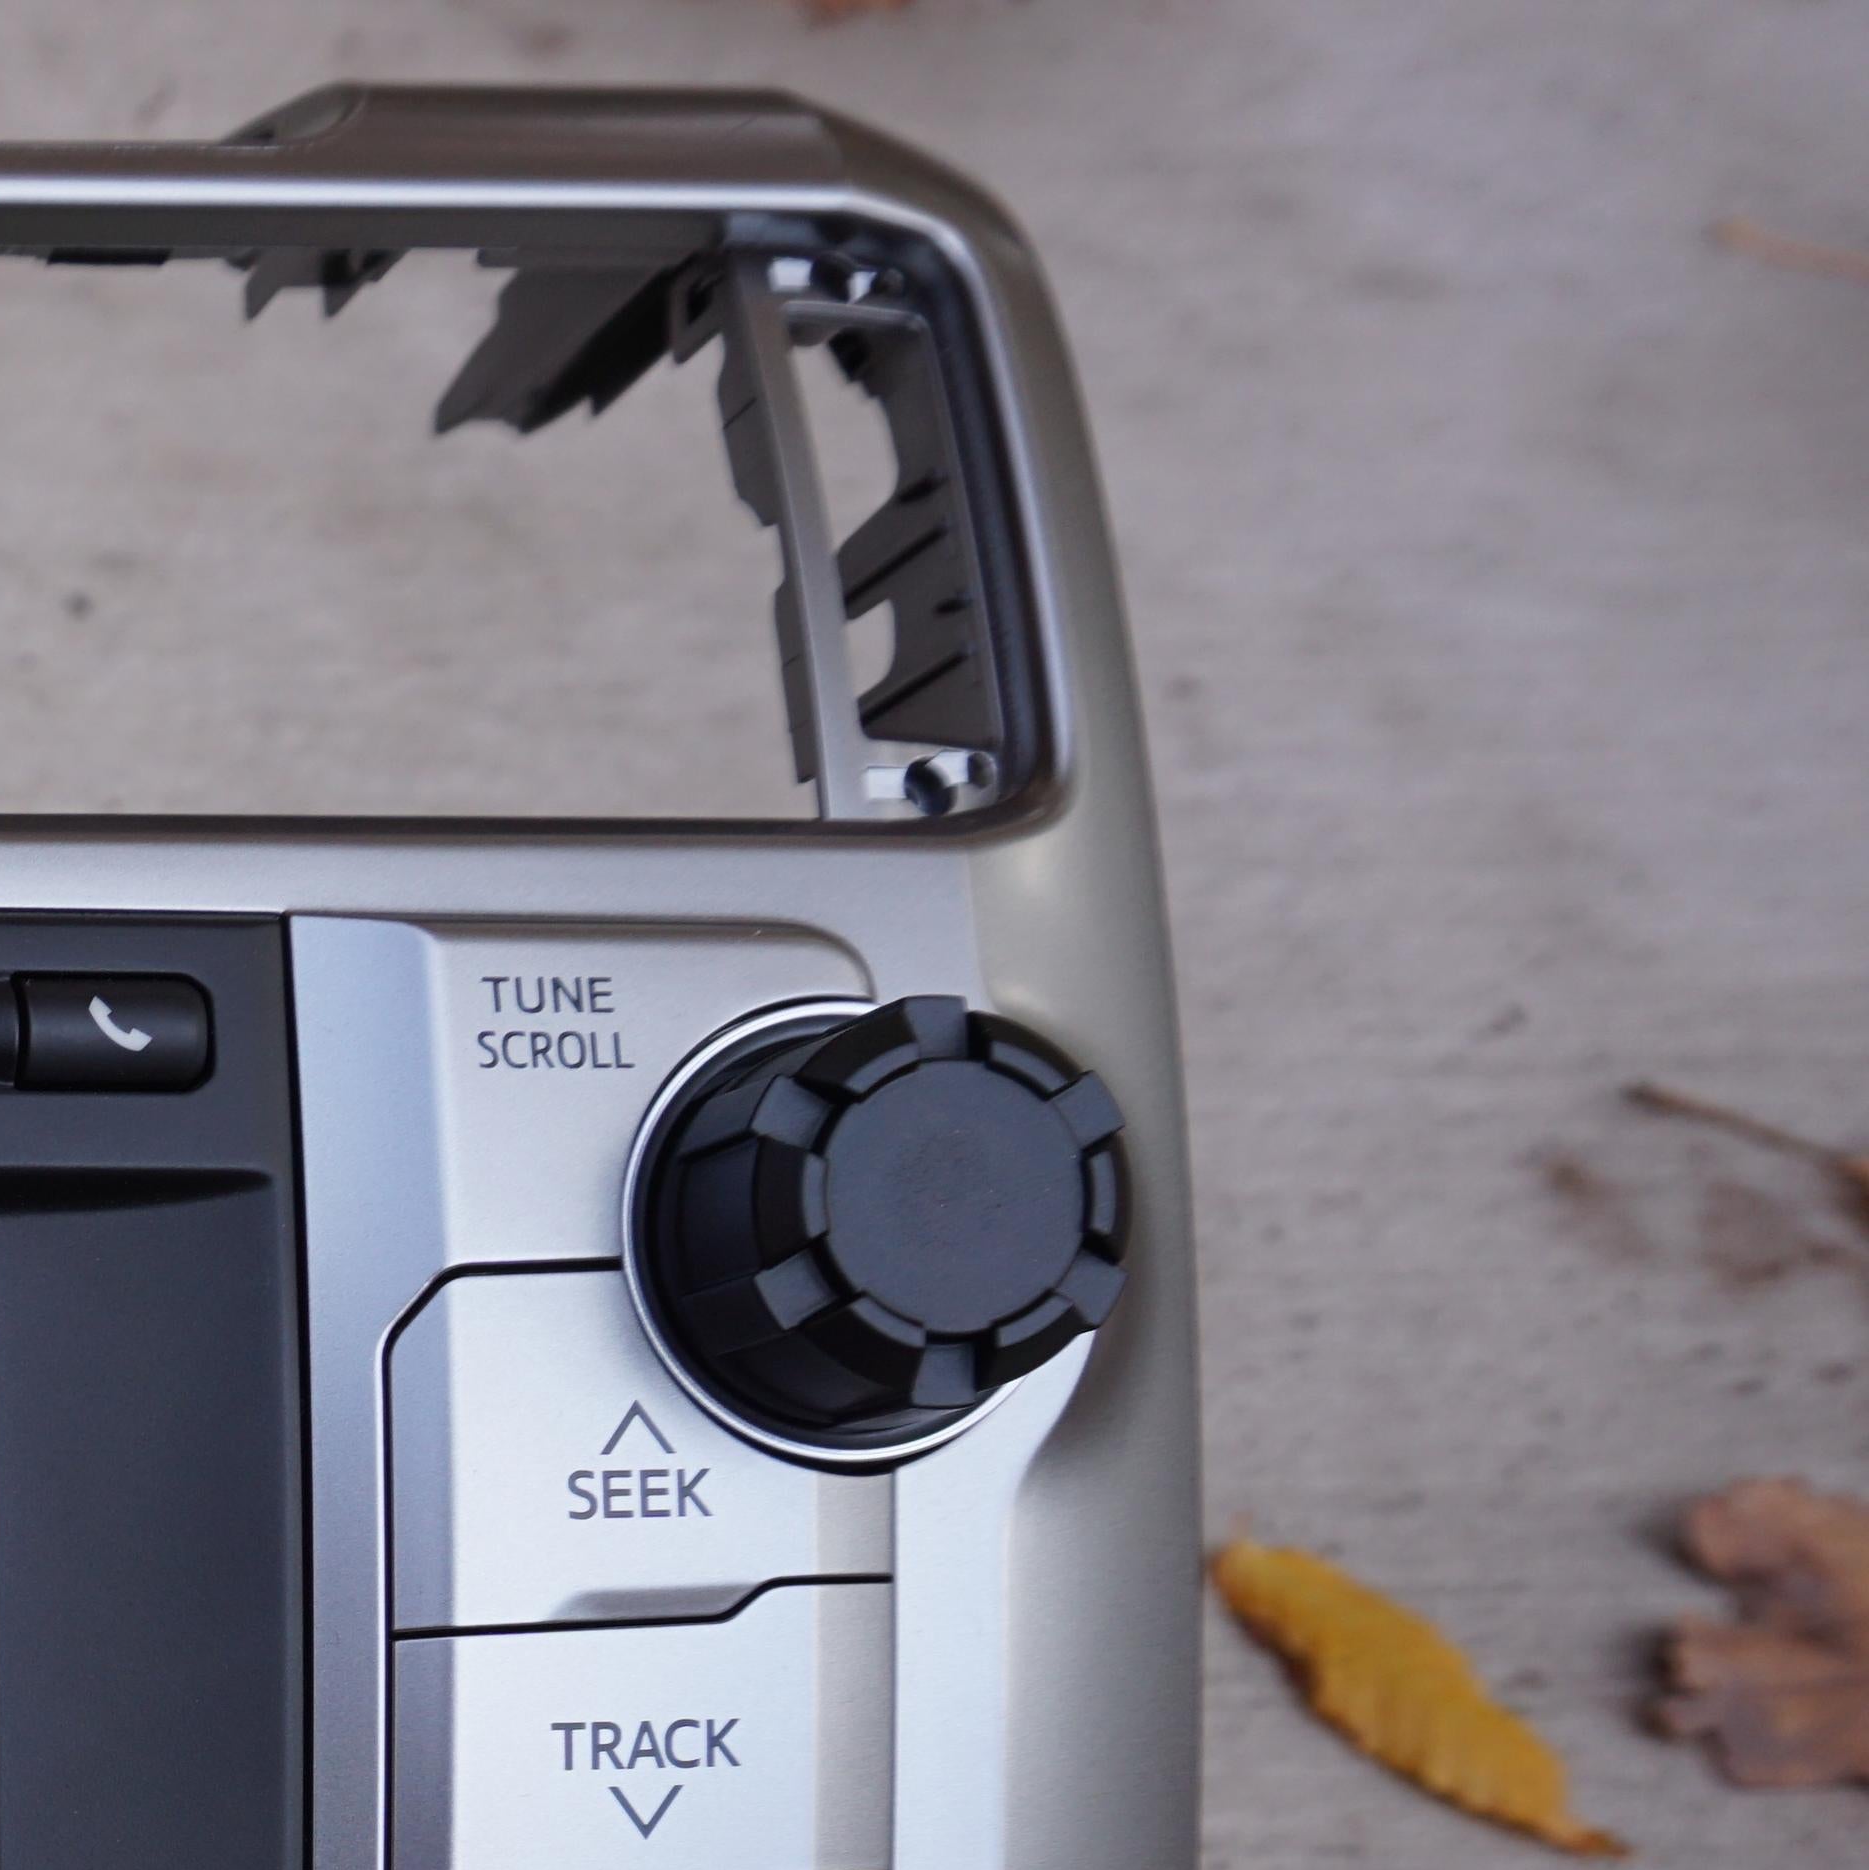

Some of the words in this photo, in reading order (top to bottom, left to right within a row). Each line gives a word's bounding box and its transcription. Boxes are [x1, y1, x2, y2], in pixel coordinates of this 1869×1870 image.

[481, 976, 616, 1014] TUNE
[476, 1030, 635, 1070] SCROLL
[567, 1468, 713, 1520] SEEK
[551, 1717, 741, 1771] TRACK
